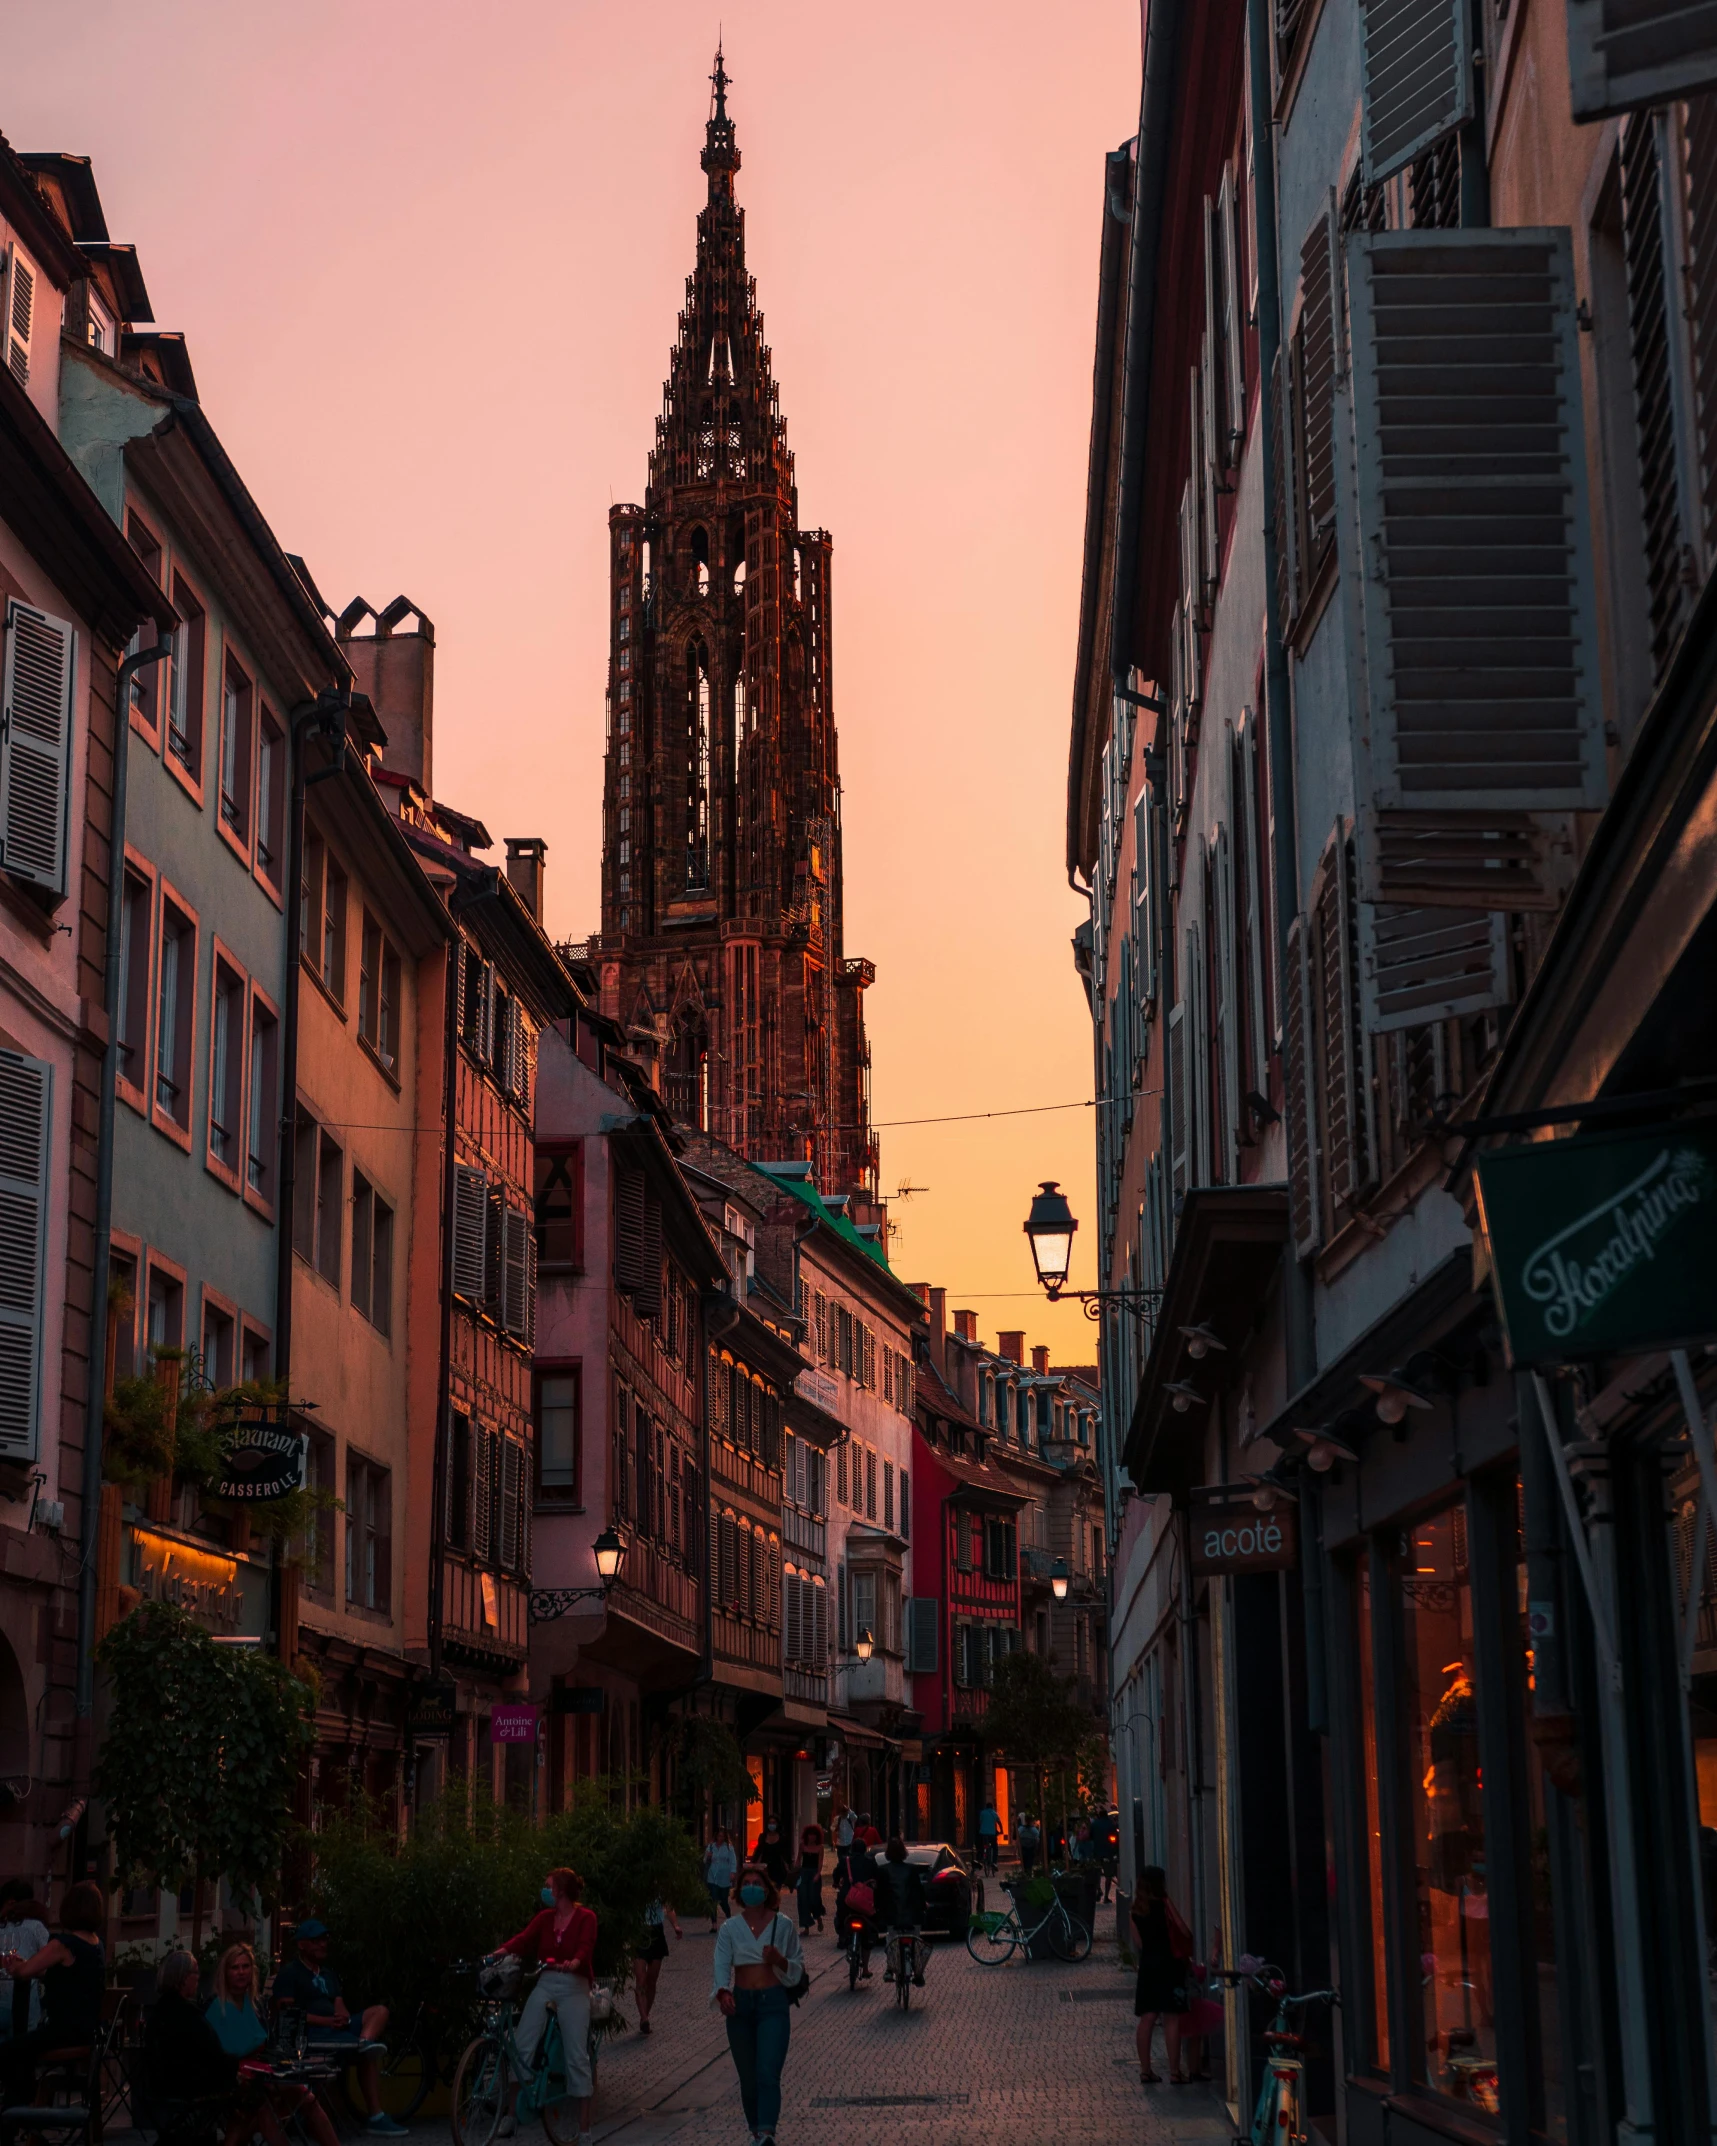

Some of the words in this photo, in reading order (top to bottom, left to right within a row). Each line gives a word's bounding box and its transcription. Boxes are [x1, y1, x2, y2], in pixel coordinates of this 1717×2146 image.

[1522, 1149, 1700, 1337] Floralpina
[217, 1428, 300, 1458] estaurant
[219, 1471, 297, 1497] CASSEROLE
[1204, 1515, 1282, 1558] acoté
[499, 1725, 511, 1737] &
[511, 1726, 527, 1737] Lili
